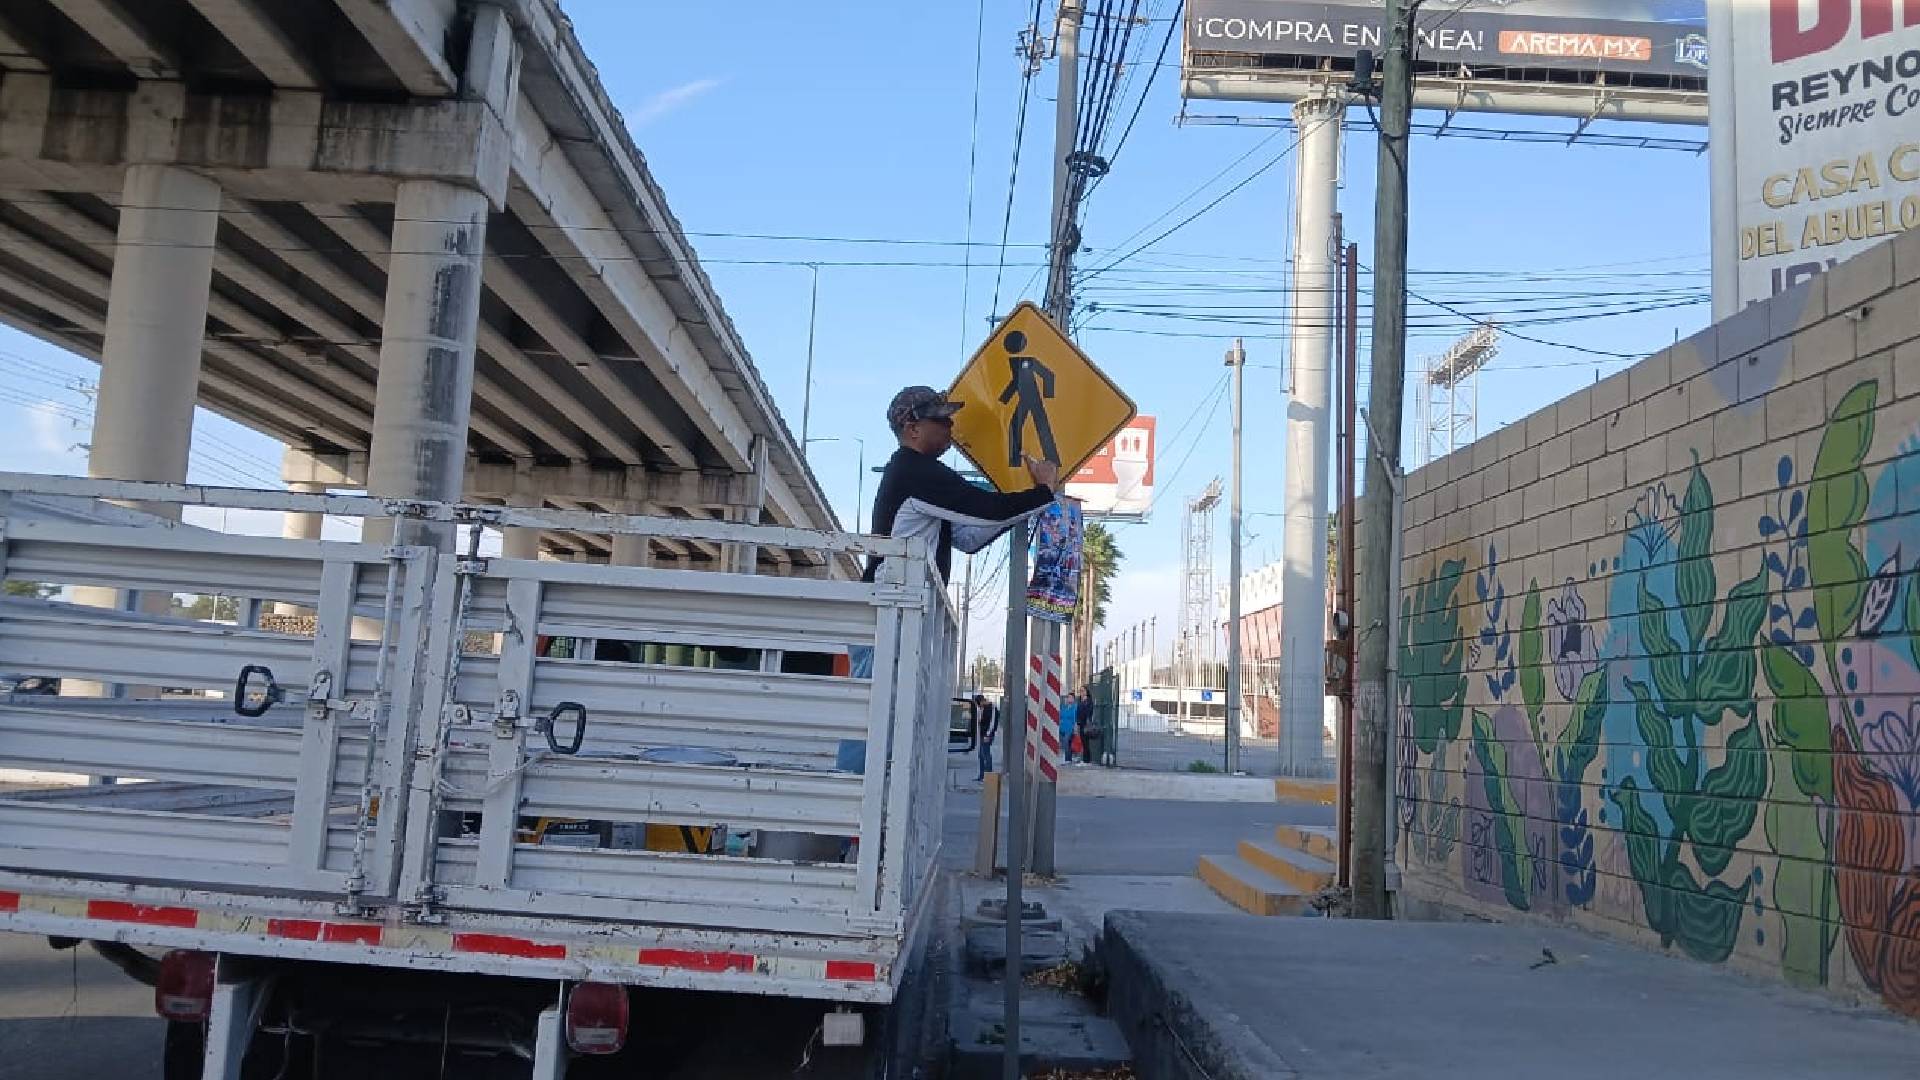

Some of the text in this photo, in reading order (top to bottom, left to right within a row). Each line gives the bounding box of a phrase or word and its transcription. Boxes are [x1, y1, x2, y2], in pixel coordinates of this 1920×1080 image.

[1197, 16, 1484, 51] ¡COMPRA EN NEA!
[1511, 32, 1641, 58] AREMA.MX
[1772, 50, 1920, 111] REYNO
[1762, 151, 1880, 208] CASA
[1741, 195, 1920, 260] DEL ABUELO
